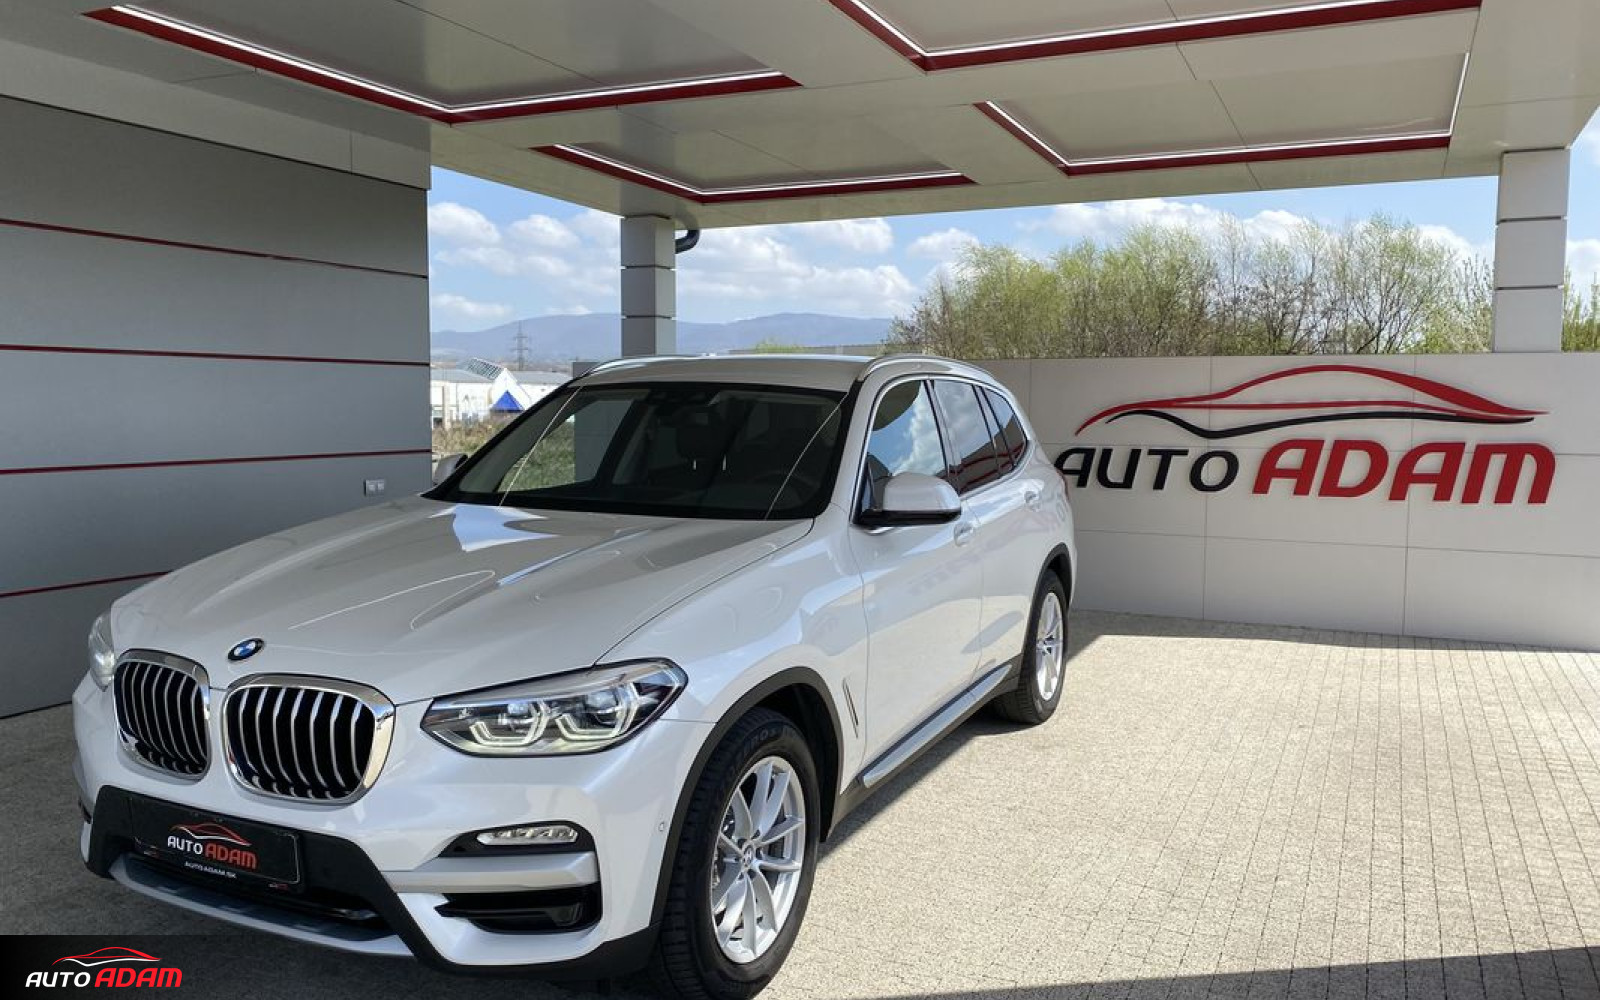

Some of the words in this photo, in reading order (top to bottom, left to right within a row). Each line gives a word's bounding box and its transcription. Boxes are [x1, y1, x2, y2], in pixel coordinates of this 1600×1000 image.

[1054, 447, 1239, 493] AUTO
[1252, 439, 1556, 505] ADAM
[167, 835, 203, 855] AUTO
[204, 843, 259, 870] ADAM
